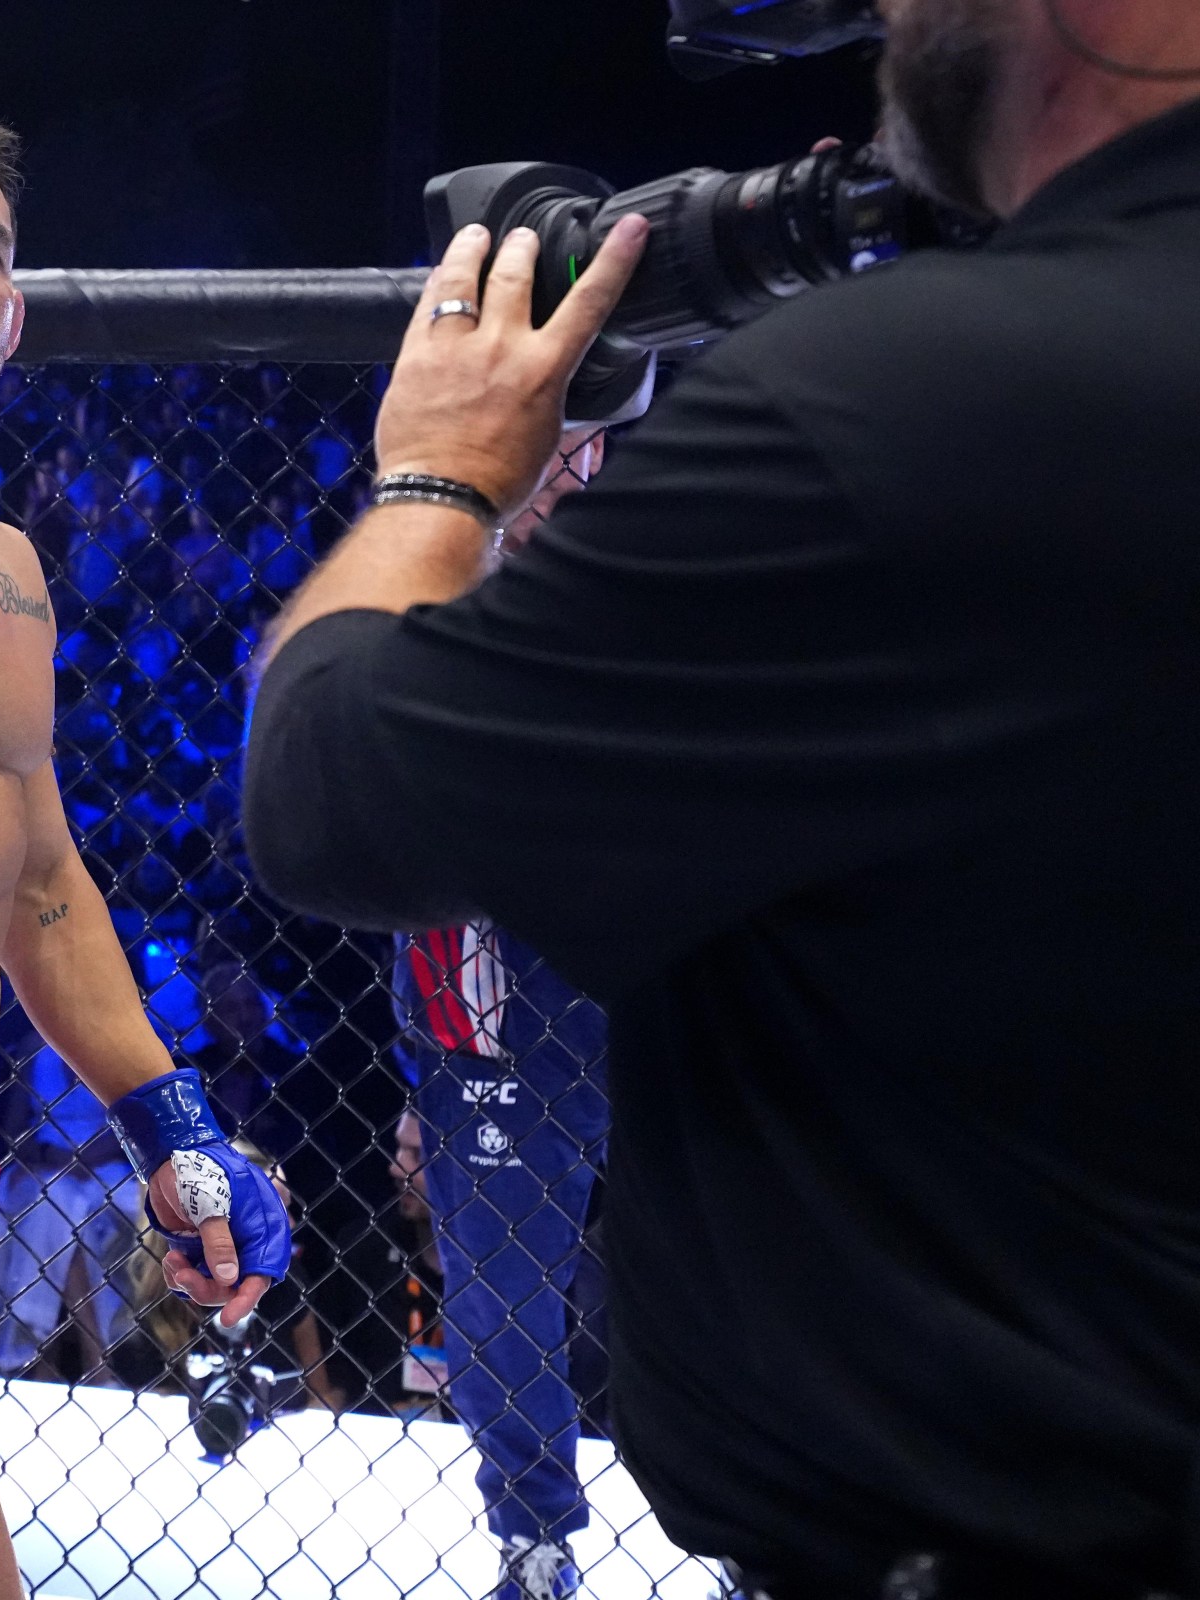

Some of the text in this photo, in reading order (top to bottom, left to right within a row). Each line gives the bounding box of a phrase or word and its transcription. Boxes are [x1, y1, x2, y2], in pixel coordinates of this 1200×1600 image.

[39, 903, 68, 927] HAP
[462, 1080, 519, 1104] UFC
[190, 1186, 200, 1216] UFC
